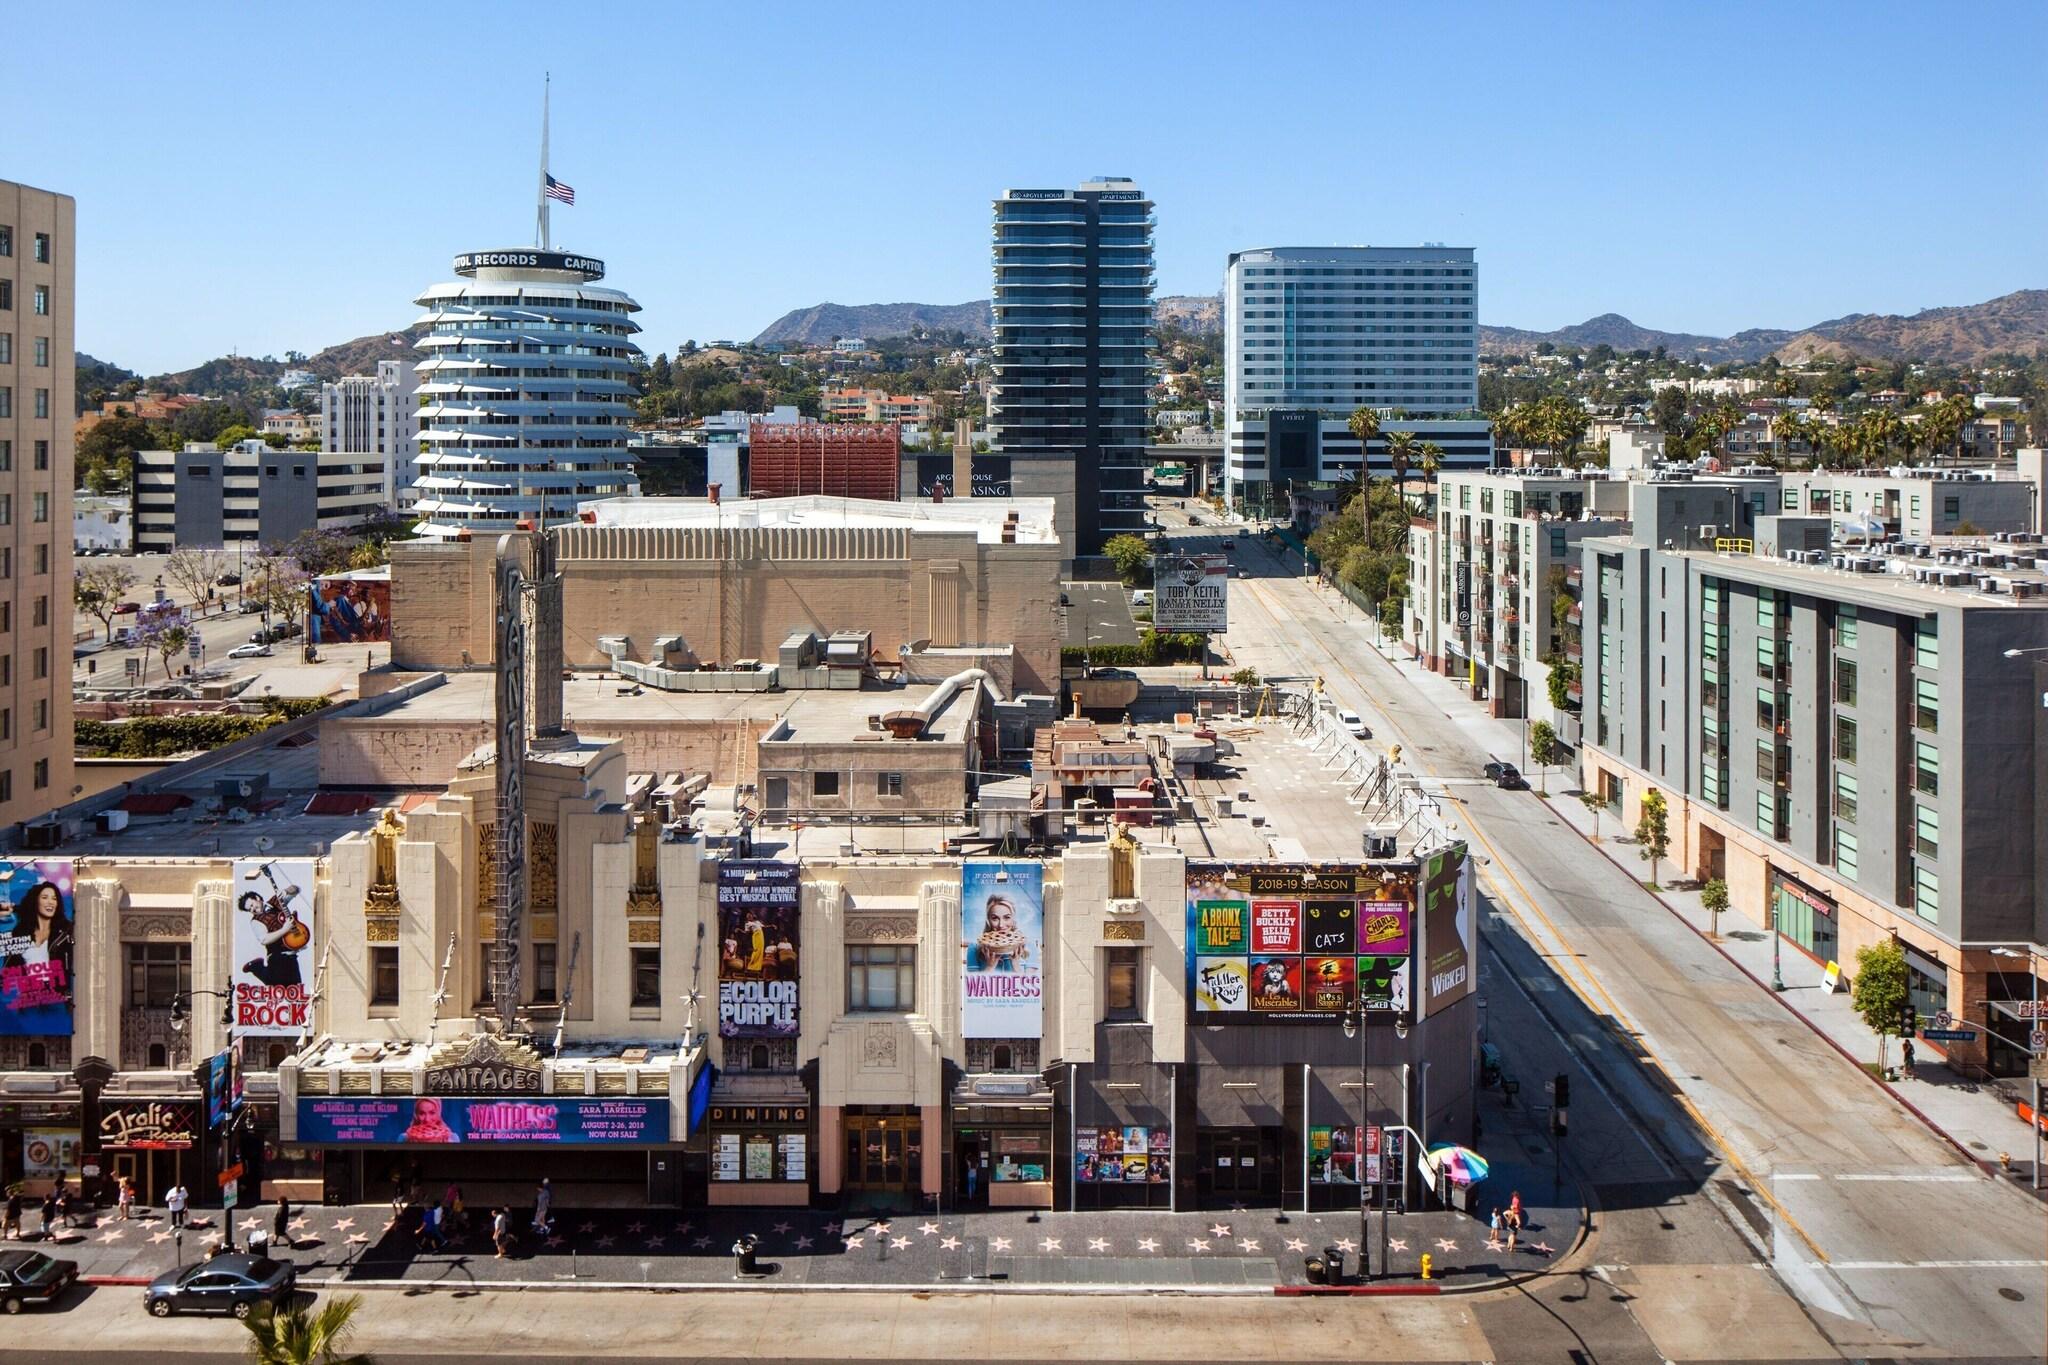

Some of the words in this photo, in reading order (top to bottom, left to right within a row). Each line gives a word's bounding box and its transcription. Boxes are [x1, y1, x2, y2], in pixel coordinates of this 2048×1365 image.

[475, 253, 538, 266] RECORDS
[565, 257, 603, 273] CAPITOL
[923, 486, 952, 496] NW
[971, 486, 1006, 496] ASING
[1167, 586, 1190, 598] TOBY
[1193, 586, 1220, 598] KEITH
[1193, 599, 1226, 609] NELLY
[734, 886, 749, 894] TONY
[750, 886, 770, 894] AWARD
[772, 886, 796, 894] WINNER!
[1258, 879, 1298, 889] 2018-19
[1300, 879, 1348, 889] SEASON
[720, 894, 740, 902] BEST
[741, 894, 768, 902] MUSICAL
[770, 894, 796, 902] REVIVAL
[1202, 908, 1208, 926] A
[1210, 908, 1240, 926] BRONX
[1261, 909, 1291, 917] BETTY
[1256, 918, 1296, 926] BUCKLEY
[1366, 915, 1398, 934] CHARLIE
[1207, 927, 1229, 945] TALE
[1263, 935, 1291, 945] DOLLY!
[1315, 933, 1345, 948] CATS
[2, 966, 22, 977] ON
[25, 960, 63, 976] YOUR
[966, 975, 1040, 997] WAITRESS
[1201, 963, 1240, 997] Fiddler
[236, 983, 310, 1002] SCHOOL
[721, 982, 732, 1003] THE
[732, 981, 797, 1003] COLOR
[1212, 985, 1243, 1005] Roof
[1254, 996, 1298, 1008] Misérables
[237, 1002, 310, 1026] ROCK
[721, 1003, 797, 1025] PURPLE
[428, 1067, 539, 1090] PANTAGES
[467, 1102, 559, 1131] WAITRESS
[579, 1106, 601, 1114] SARA
[604, 1106, 647, 1114] BAREILLES
[714, 1108, 805, 1120] DINING
[101, 1103, 174, 1145] Frolic
[611, 1122, 627, 1130] 2-26,
[150, 1127, 190, 1139] Room
